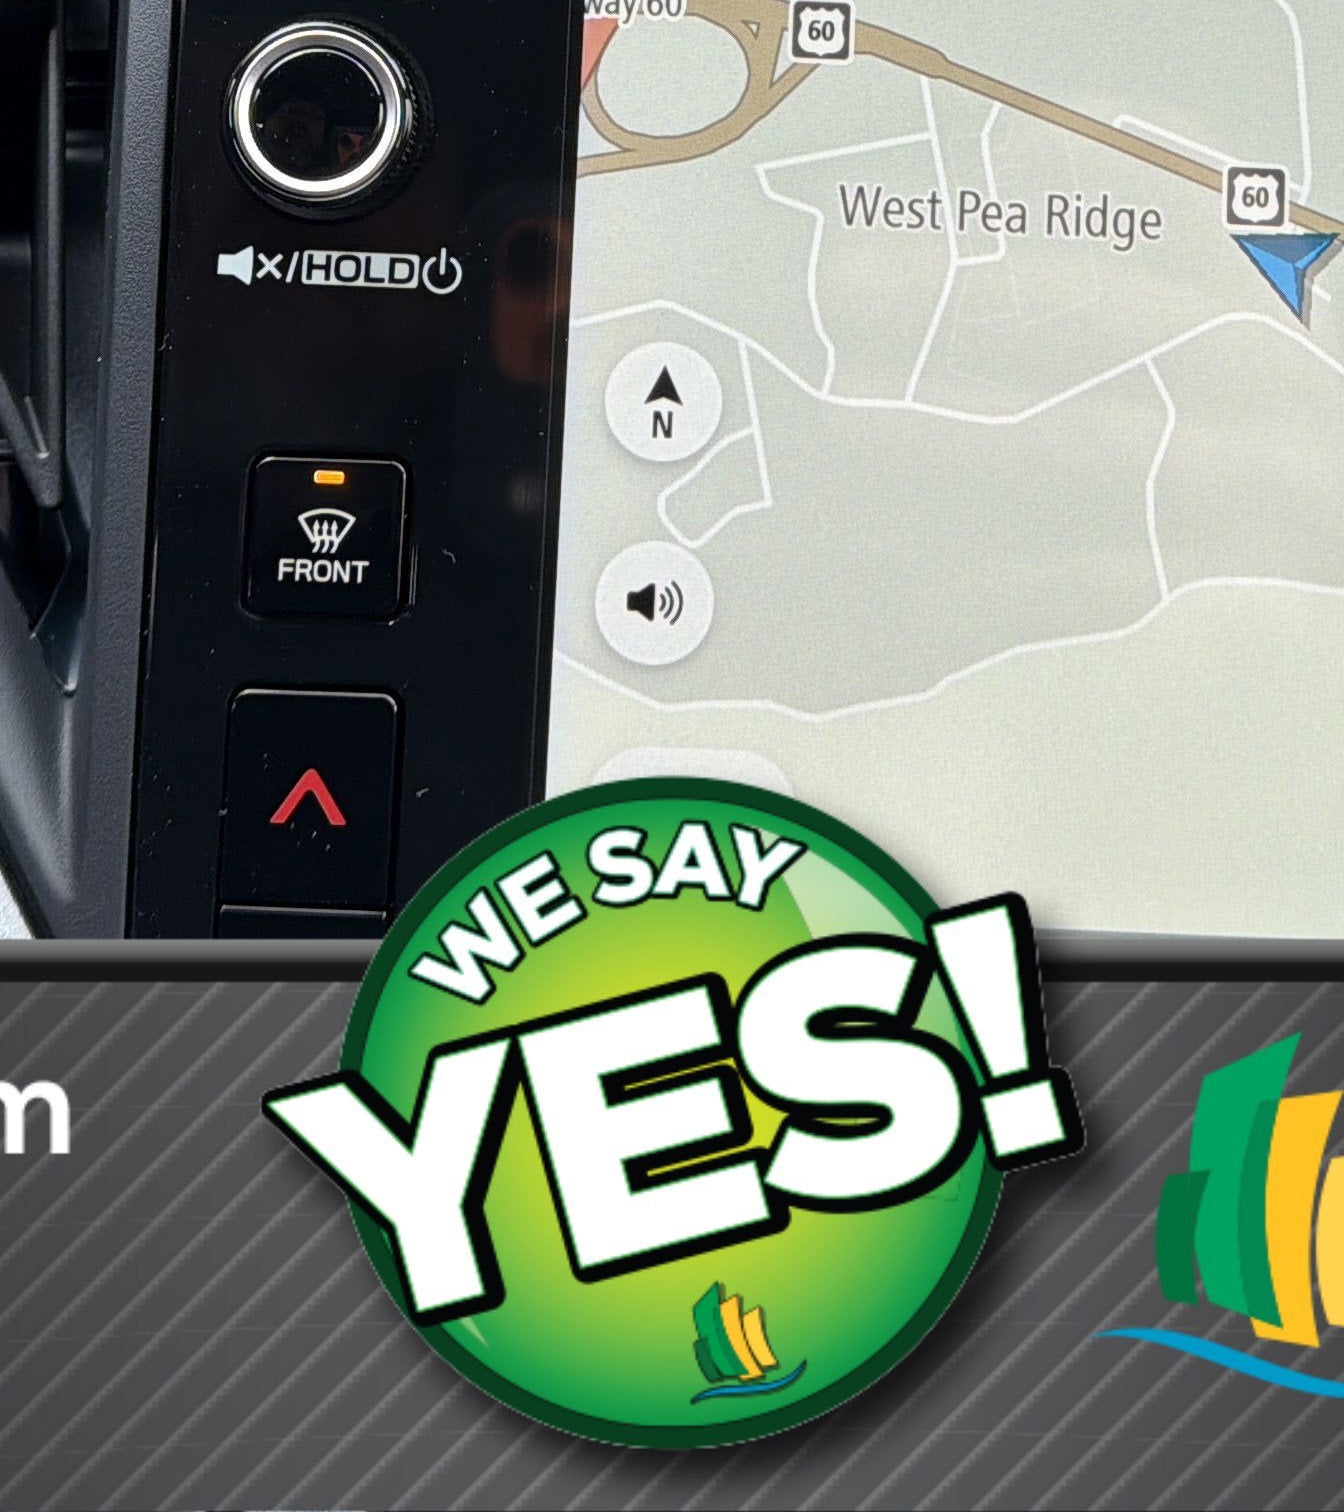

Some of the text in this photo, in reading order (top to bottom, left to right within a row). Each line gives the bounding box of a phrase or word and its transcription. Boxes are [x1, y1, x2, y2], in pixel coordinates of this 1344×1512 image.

[807, 19, 835, 42] 60
[1241, 186, 1270, 209] 60
[838, 183, 1163, 251] West Pea Ridge
[651, 412, 674, 439] N
[277, 558, 370, 584] FRONT
